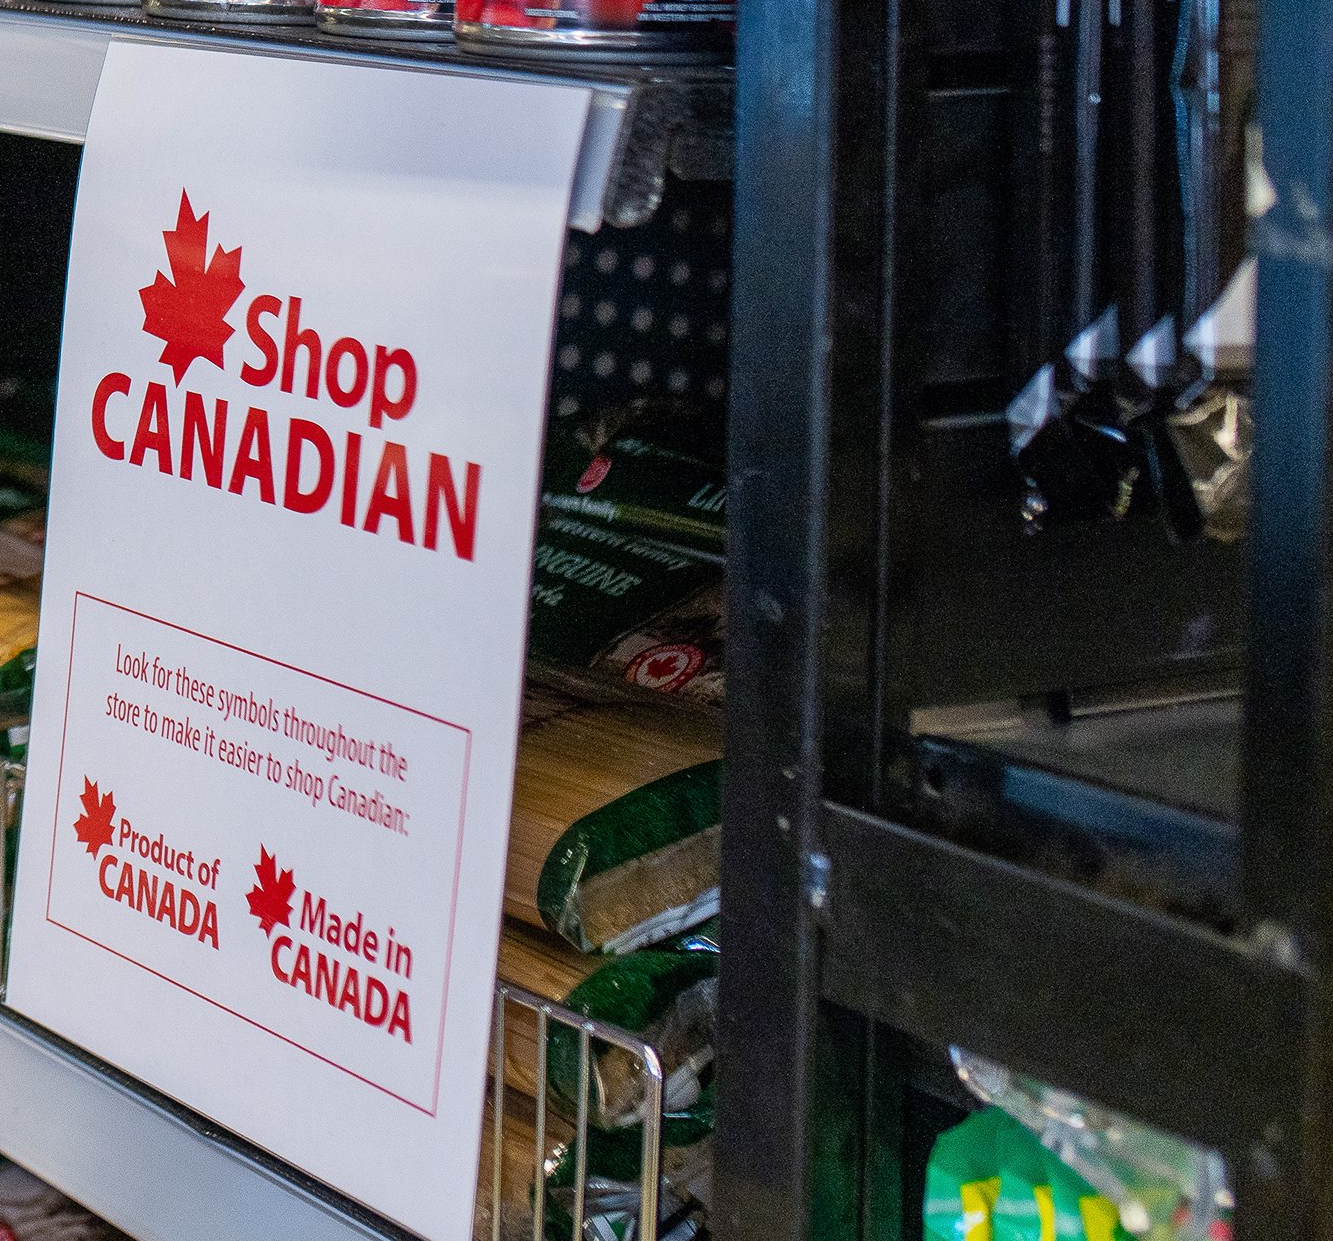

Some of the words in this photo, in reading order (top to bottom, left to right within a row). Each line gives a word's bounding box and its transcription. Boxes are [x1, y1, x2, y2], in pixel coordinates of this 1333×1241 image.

[240, 294, 418, 428] Shop
[91, 372, 482, 563] CANADIAN
[105, 692, 140, 727] store
[144, 704, 158, 734] to
[161, 716, 201, 751] make
[204, 726, 216, 758] it
[218, 738, 264, 777] easier
[266, 752, 283, 784] to
[284, 758, 325, 808] shop
[327, 774, 411, 837] Canadian:
[116, 643, 149, 683] Look
[152, 656, 173, 691] for
[175, 666, 215, 707] these
[218, 690, 279, 732] symbols
[283, 706, 376, 770] throughout
[379, 737, 409, 782] the
[98, 854, 220, 952] CANADA
[119, 817, 195, 881] Product
[197, 858, 221, 890] of
[270, 935, 413, 1046] CANADA
[299, 889, 379, 964] Made
[386, 926, 413, 980] in
